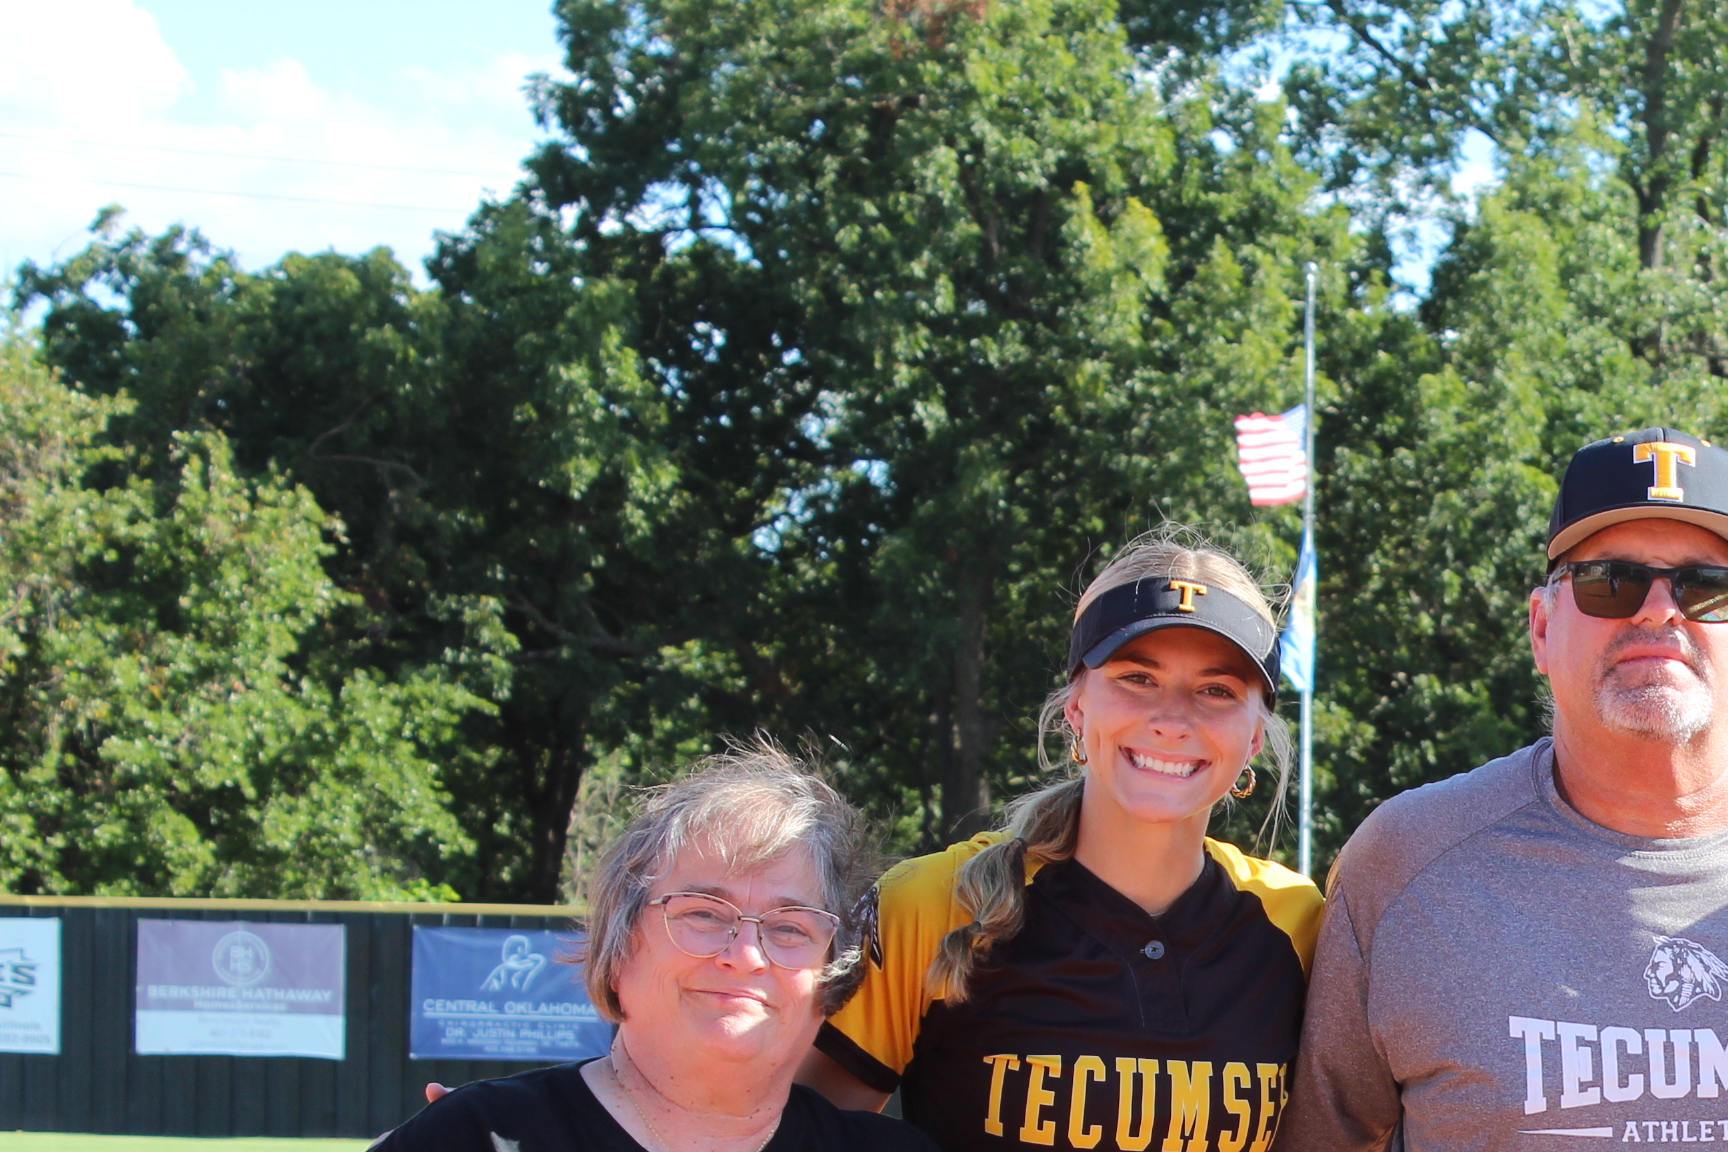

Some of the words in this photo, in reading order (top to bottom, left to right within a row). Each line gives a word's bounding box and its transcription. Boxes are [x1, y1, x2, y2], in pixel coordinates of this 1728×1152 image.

[1633, 442, 1696, 502] T
[1169, 580, 1207, 613] T
[148, 985, 237, 999] BERKSHIRE
[242, 987, 333, 1001] HATHAWAY
[423, 999, 498, 1013] CENTRAL
[504, 1001, 597, 1016] OKLAHOMA
[473, 1027, 514, 1038] JUSTIN
[519, 1028, 575, 1040] PHILLIPS
